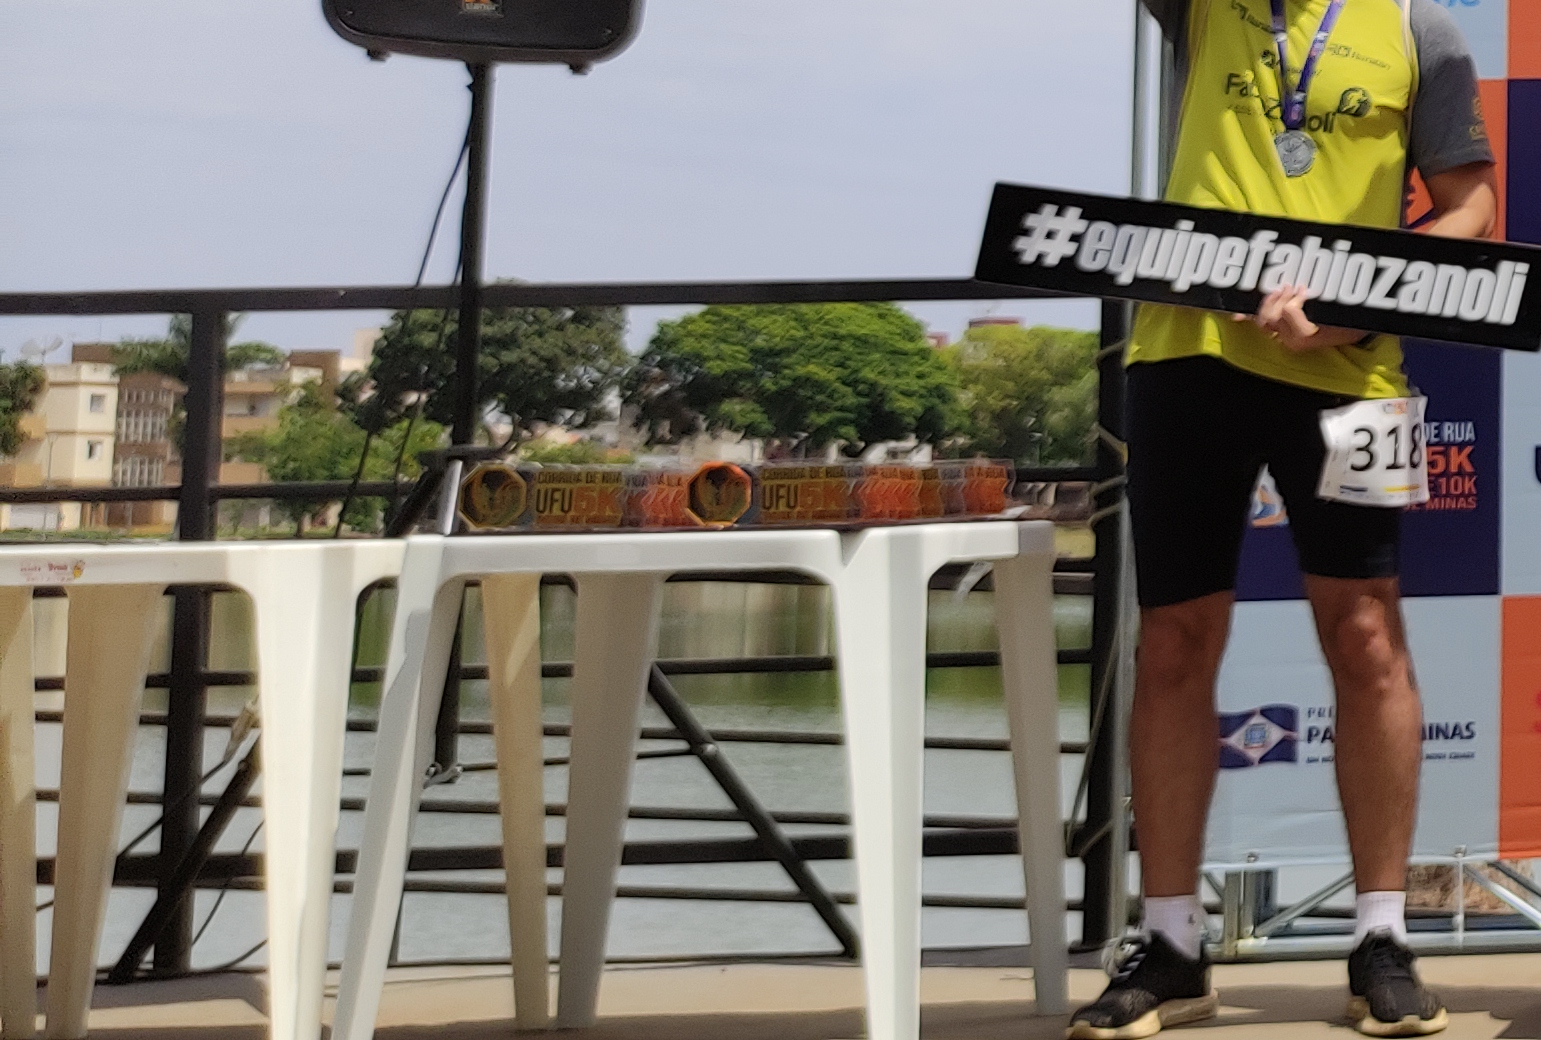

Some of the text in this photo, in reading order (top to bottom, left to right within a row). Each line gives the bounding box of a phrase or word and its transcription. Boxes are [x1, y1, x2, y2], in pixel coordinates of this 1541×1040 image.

[1012, 202, 1530, 326] #equipefabiozanoli
[1444, 422, 1476, 442] RUA
[1351, 422, 1423, 471] 318
[1427, 445, 1475, 474] 5K
[535, 487, 573, 514] UFU
[762, 483, 799, 511] UFU
[1426, 497, 1477, 510] MINAS
